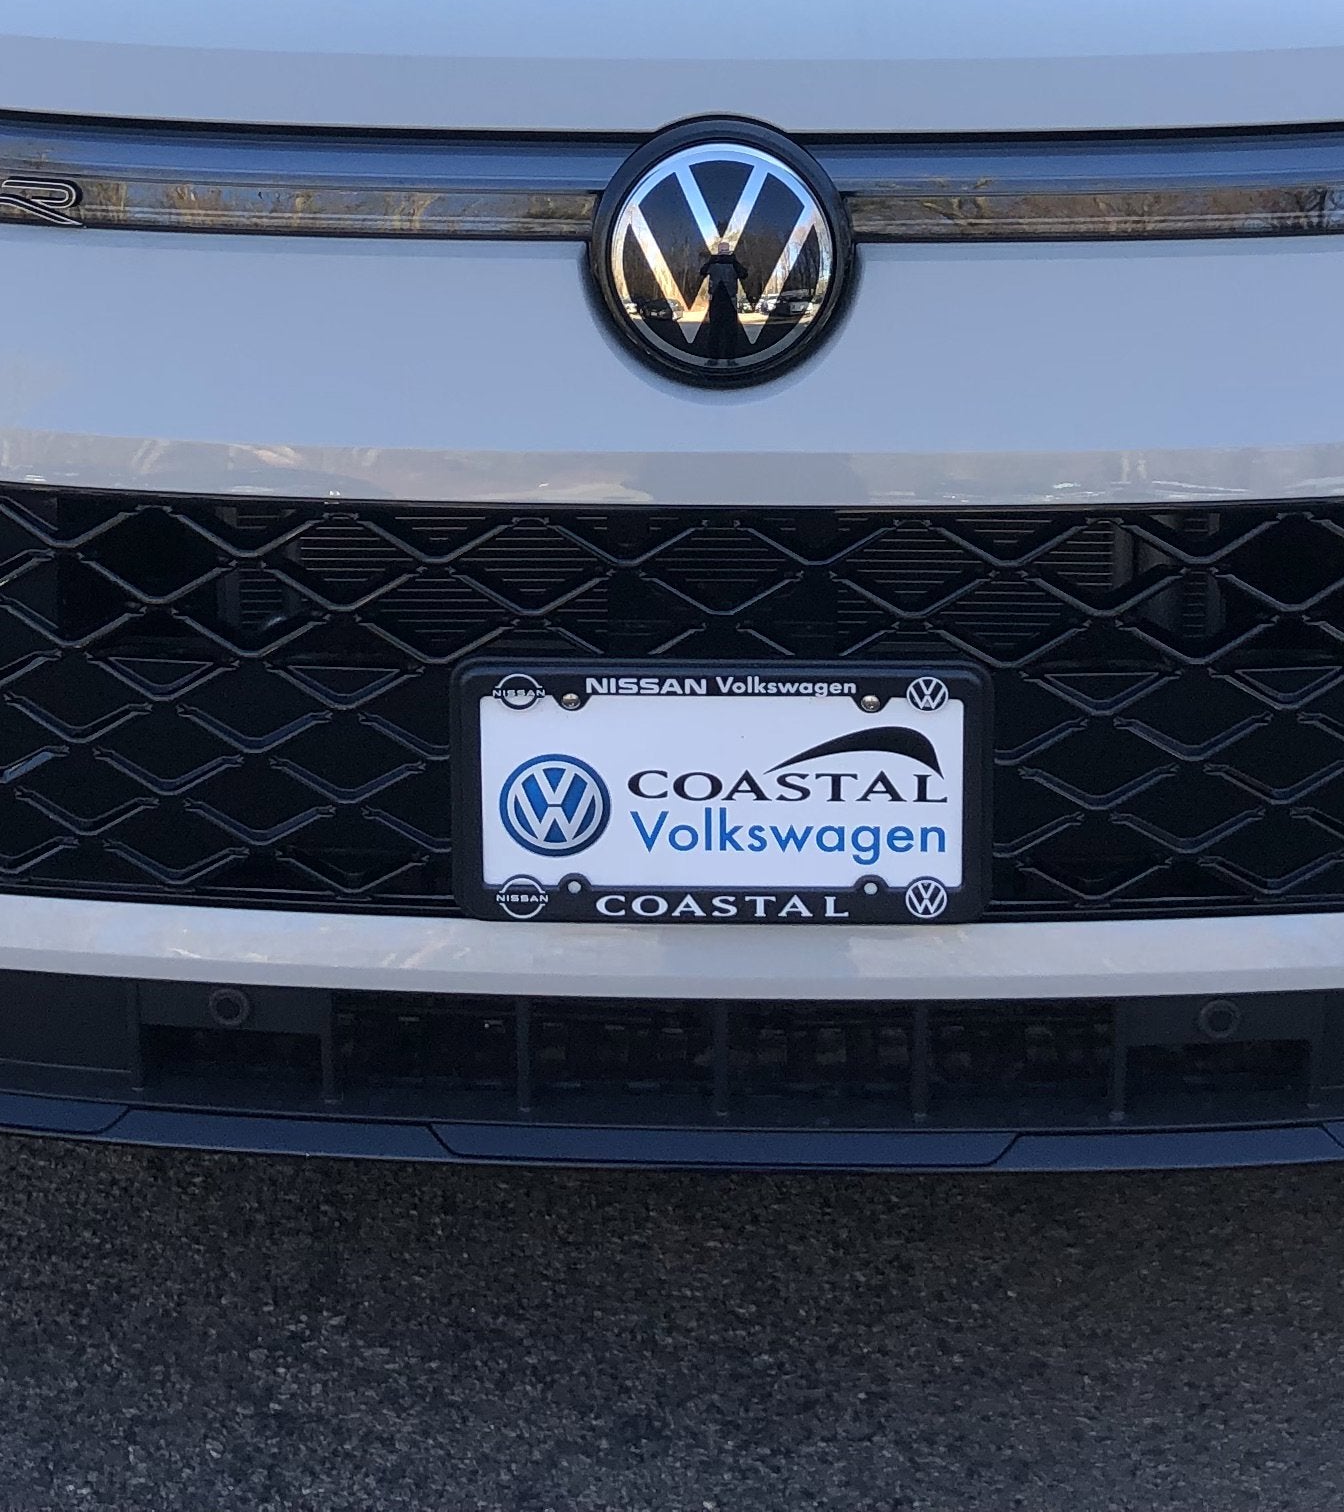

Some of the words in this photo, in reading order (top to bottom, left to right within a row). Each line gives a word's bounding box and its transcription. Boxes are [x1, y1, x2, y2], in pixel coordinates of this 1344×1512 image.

[611, 145, 833, 367] VW
[492, 688, 546, 698] NISSAN
[585, 676, 707, 695] NISSAN
[715, 675, 856, 697] Volkswagen
[907, 676, 949, 712] VW
[627, 769, 948, 803] COASTAL
[506, 759, 604, 852] VW
[630, 806, 946, 866] Volkswagen
[495, 892, 549, 903] NISSAN
[594, 894, 850, 919] COASTAL
[905, 880, 948, 919] VW
